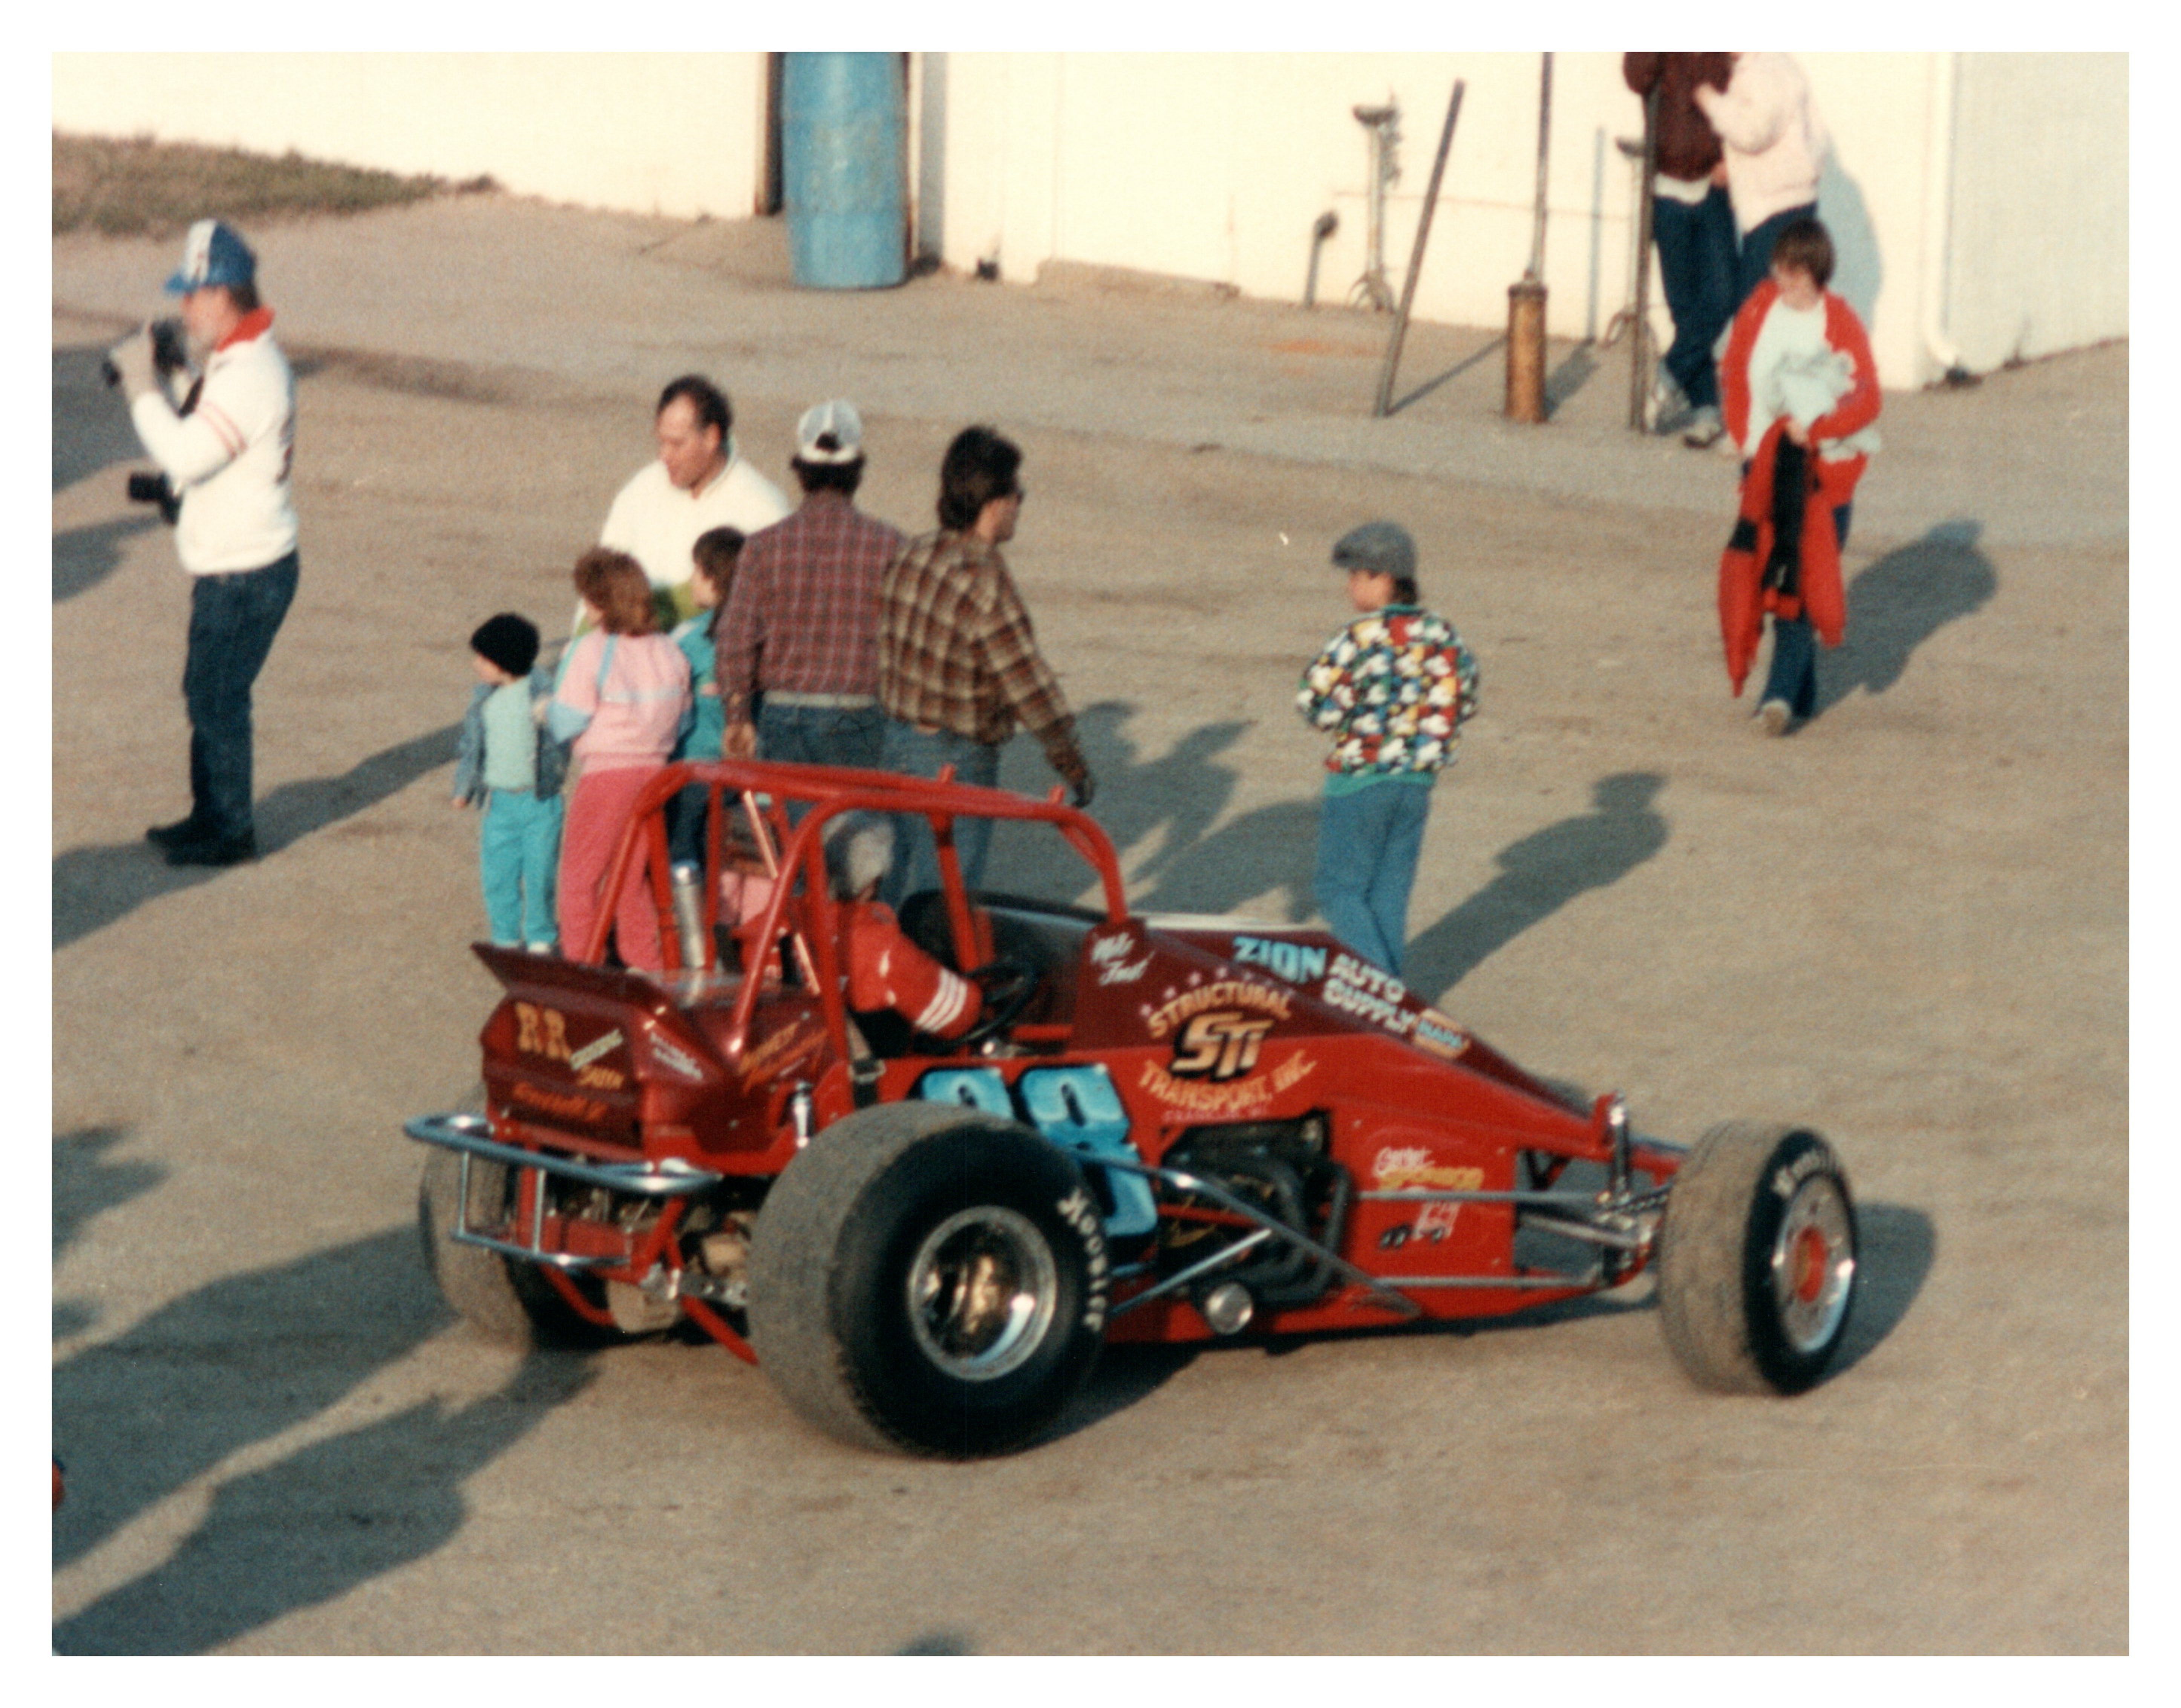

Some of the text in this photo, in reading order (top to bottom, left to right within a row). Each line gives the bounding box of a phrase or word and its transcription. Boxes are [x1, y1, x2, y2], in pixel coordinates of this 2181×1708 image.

[1233, 936, 1406, 1003] ZION AUTO
[1148, 981, 1291, 1039] STRUCTURAL
[1322, 978, 1416, 1033] SUPPLY
